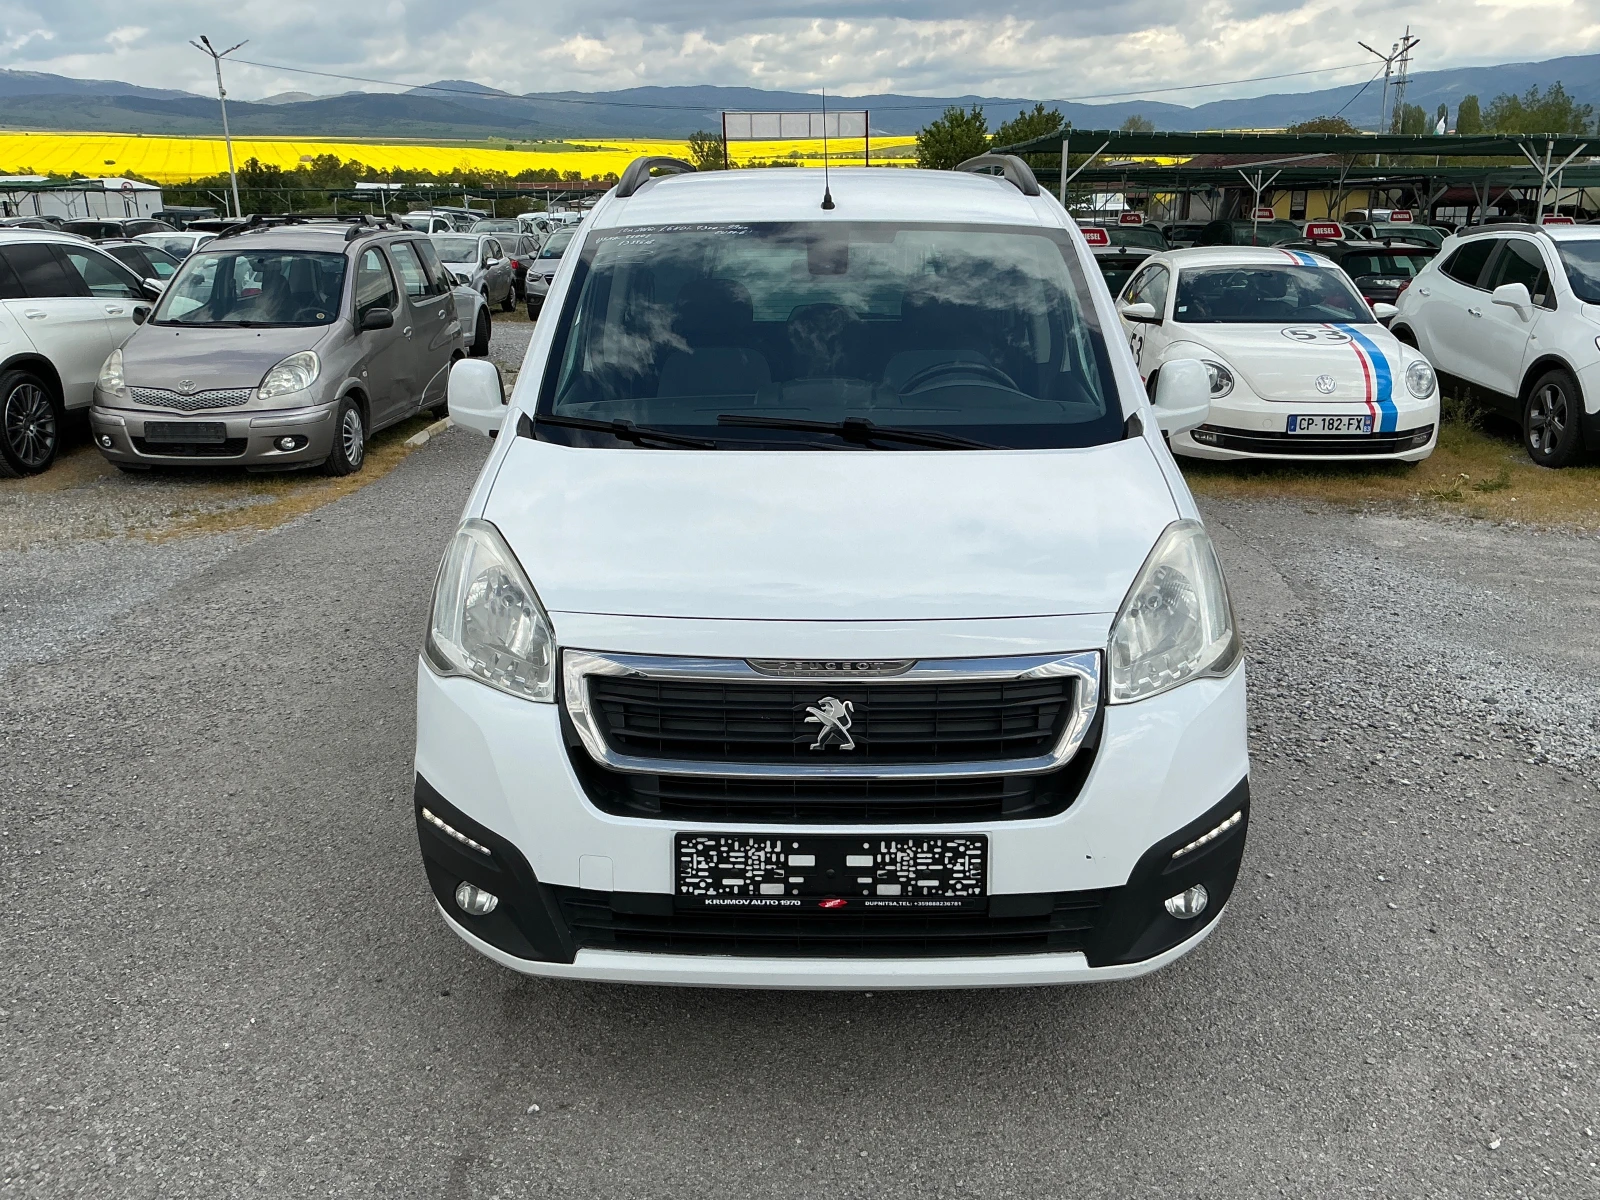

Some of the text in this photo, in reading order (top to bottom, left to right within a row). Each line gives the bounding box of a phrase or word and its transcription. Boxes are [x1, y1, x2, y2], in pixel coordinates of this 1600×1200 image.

[1313, 227, 1335, 235] DIESEL
[1288, 329, 1348, 340] 53
[1299, 417, 1363, 431] CP-182-FX
[778, 662, 885, 670] PEUGEOT
